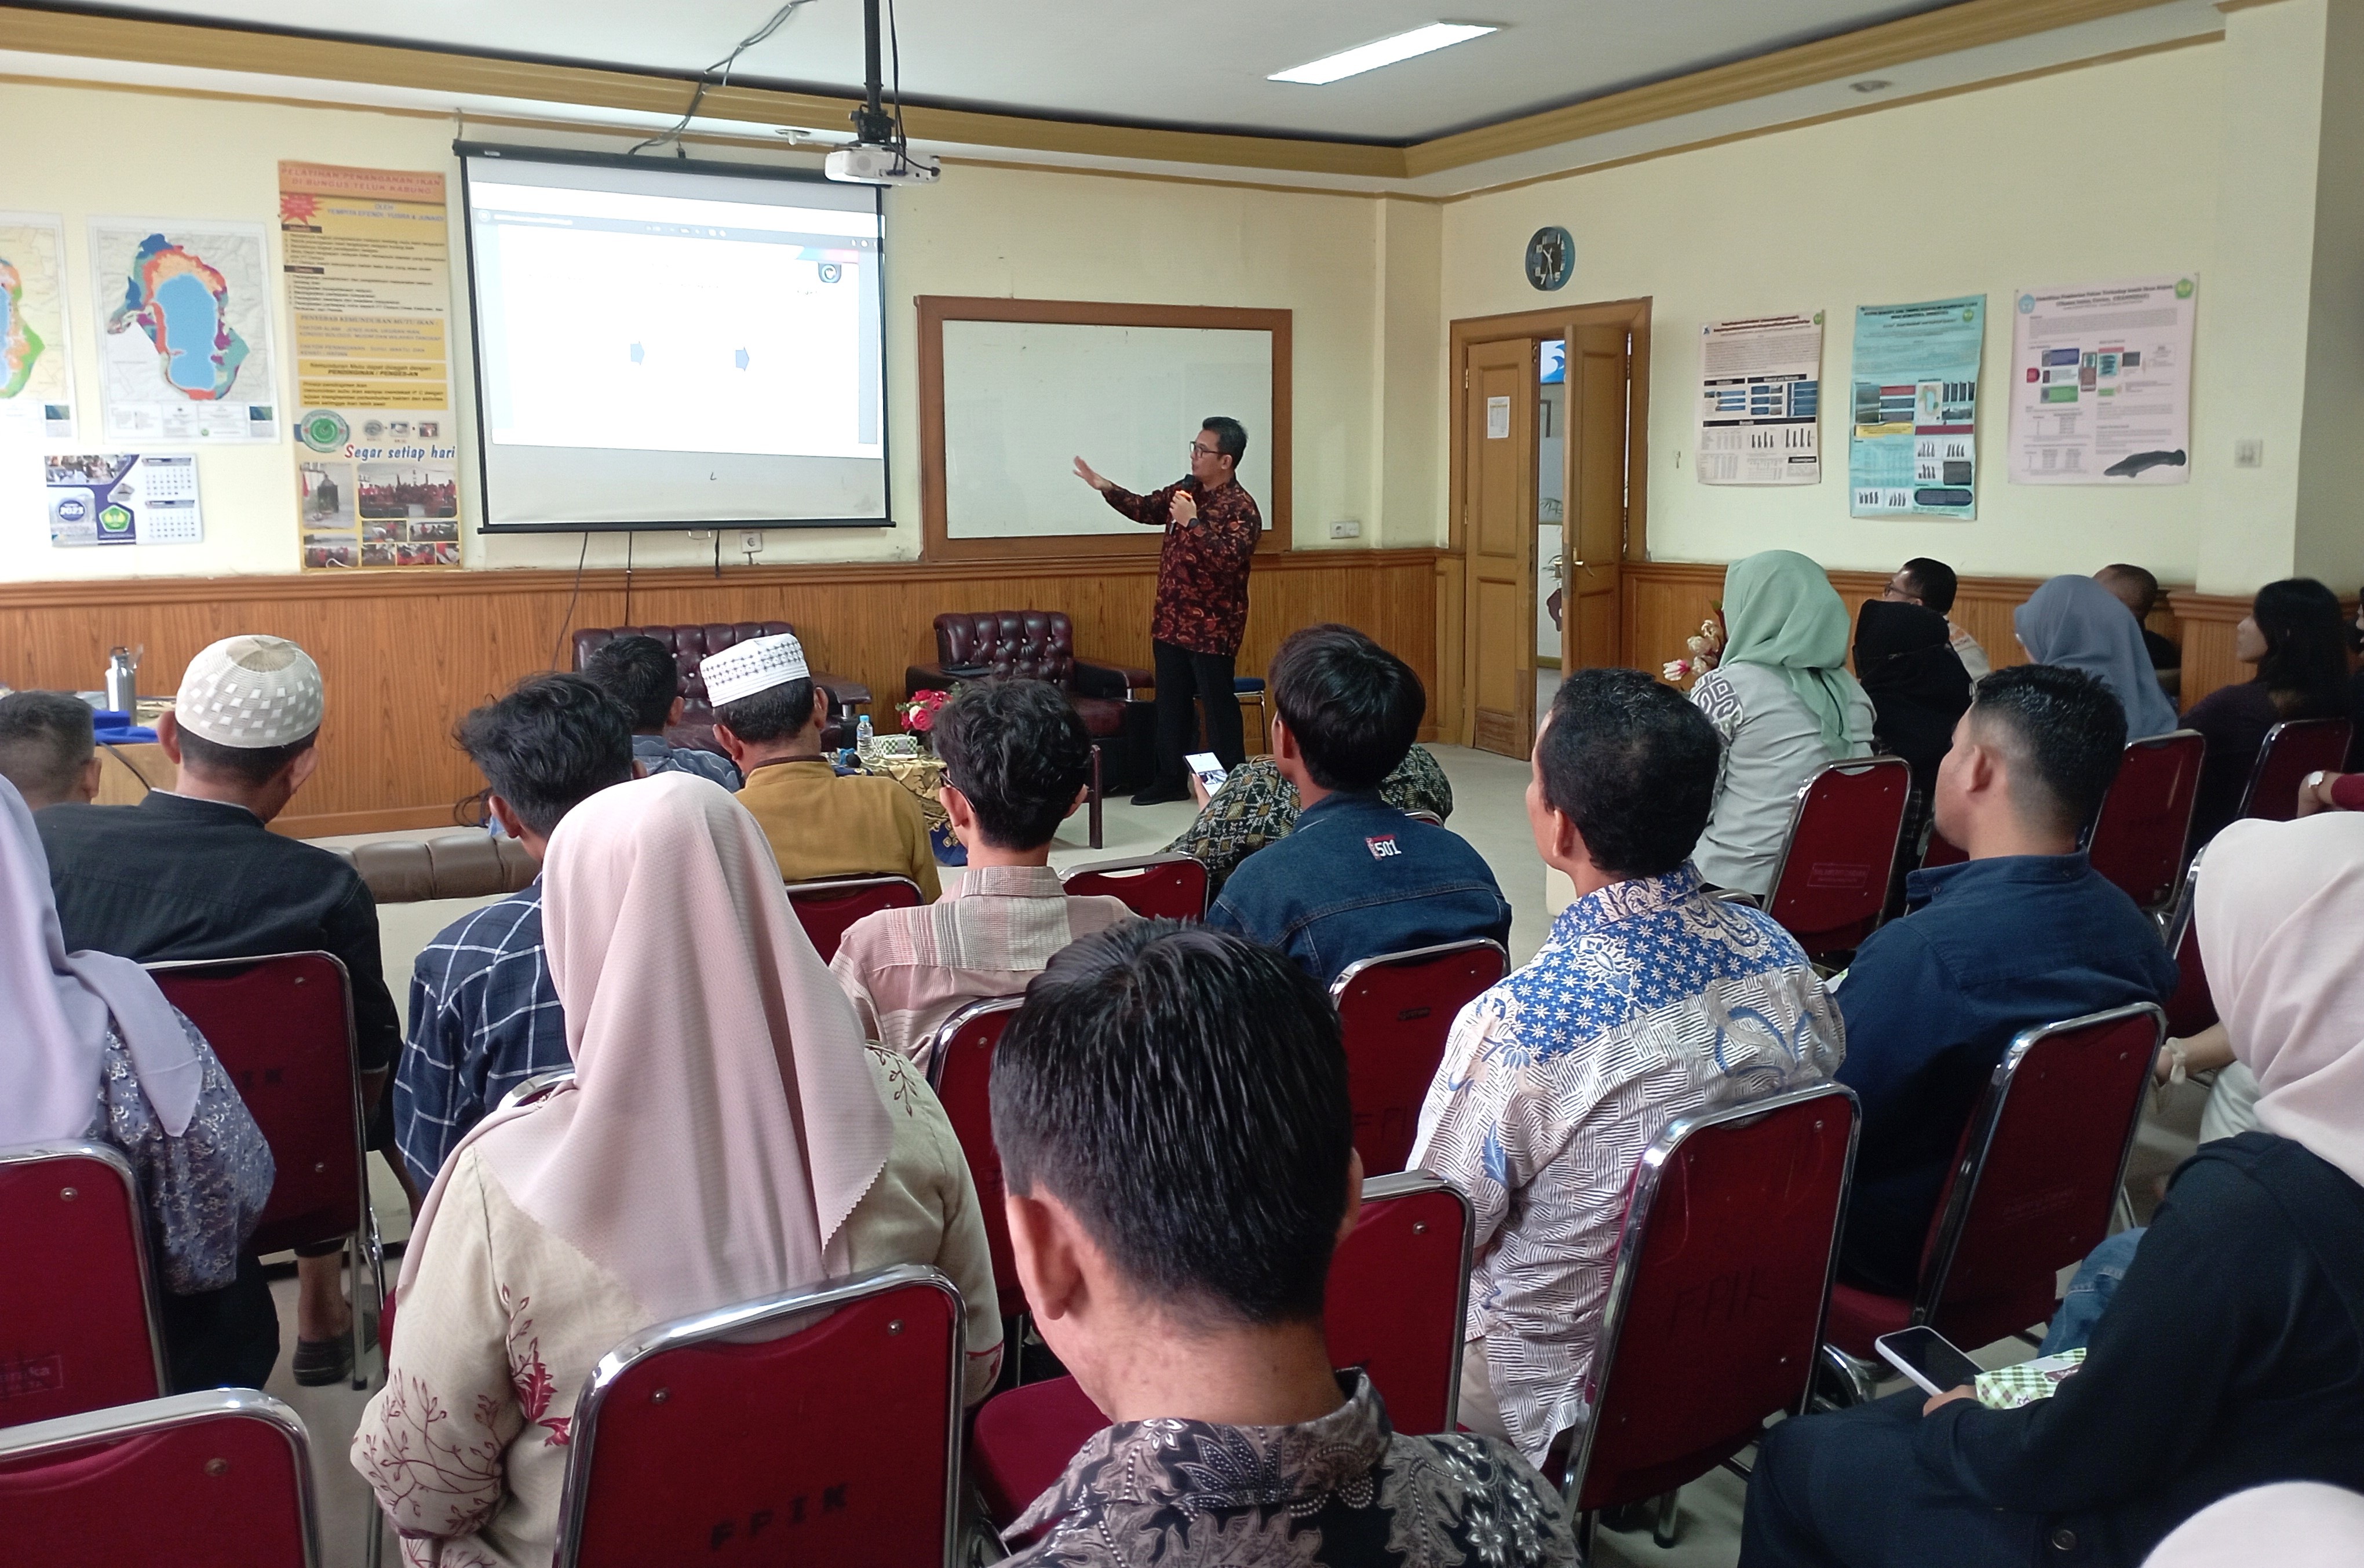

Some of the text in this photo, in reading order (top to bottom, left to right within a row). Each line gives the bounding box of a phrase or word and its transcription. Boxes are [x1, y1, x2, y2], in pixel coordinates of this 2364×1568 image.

[344, 444, 455, 462] Segar setiap hari
[1374, 839, 1402, 857] 501
[710, 1481, 850, 1552] FPIK
